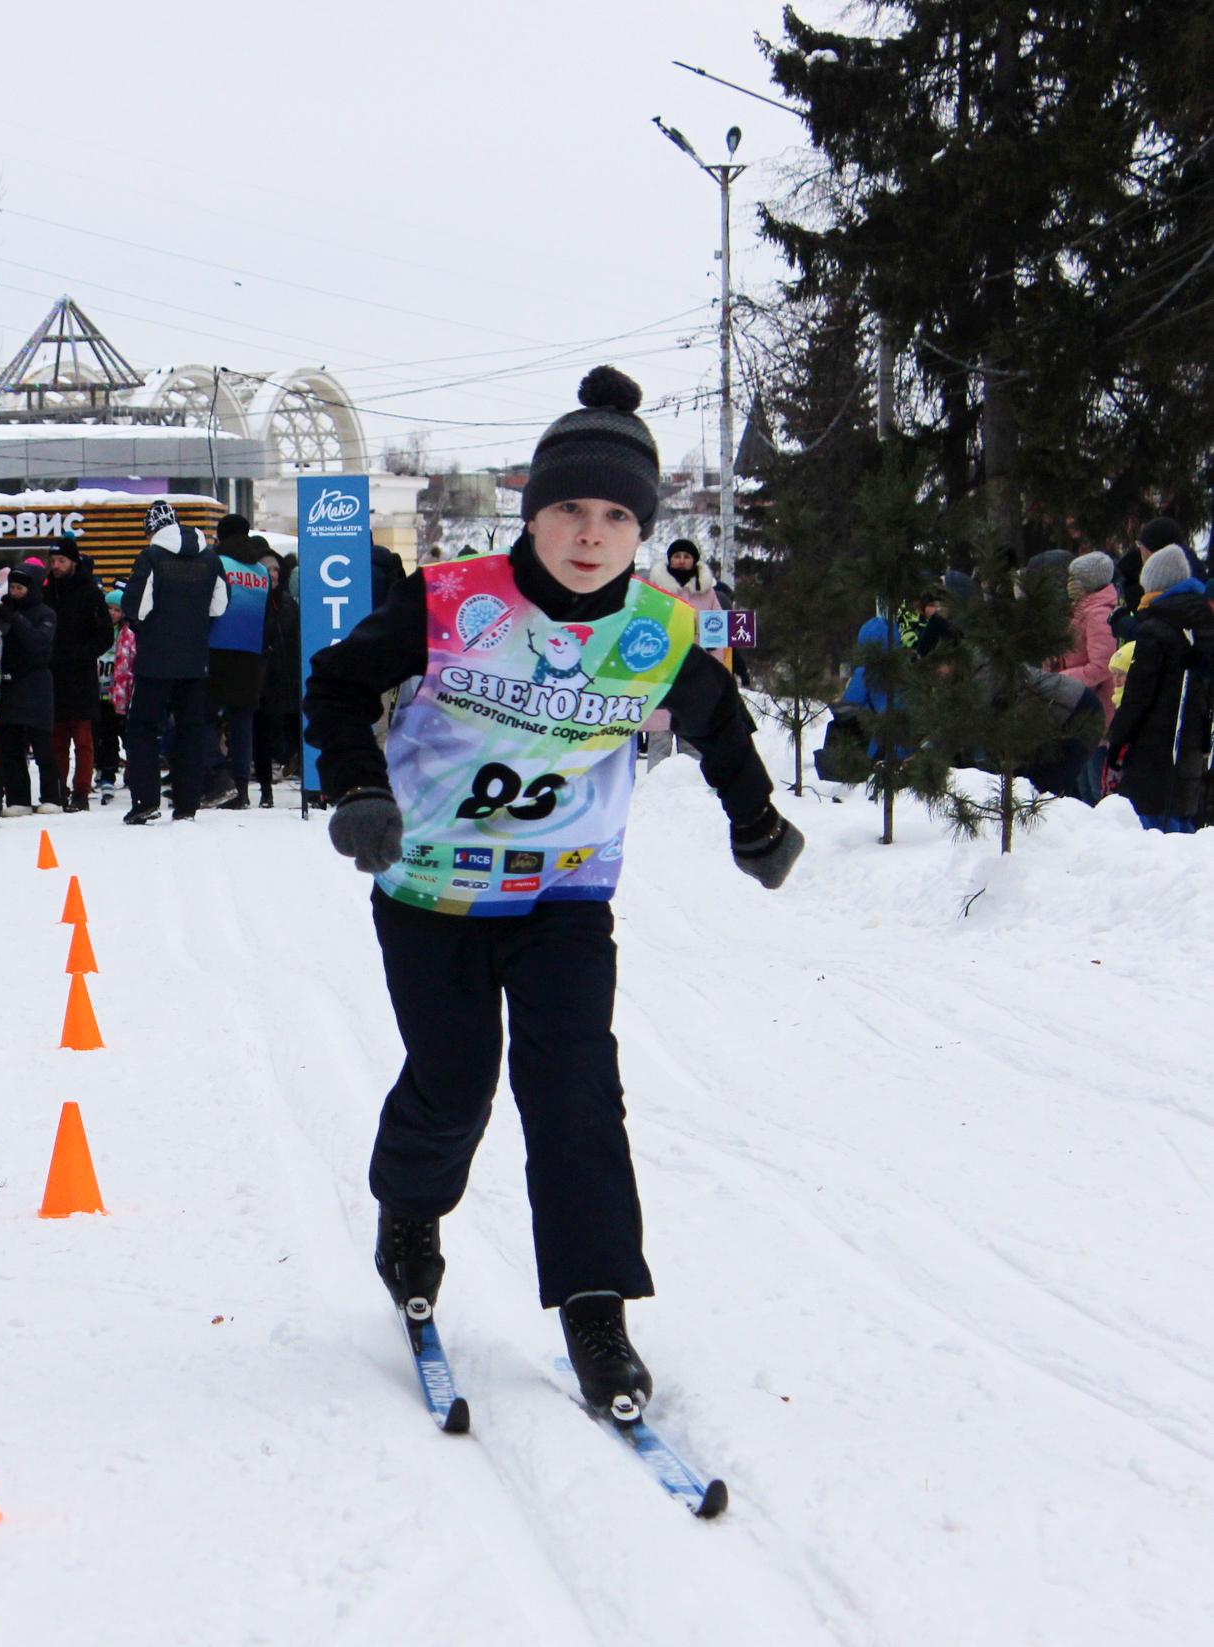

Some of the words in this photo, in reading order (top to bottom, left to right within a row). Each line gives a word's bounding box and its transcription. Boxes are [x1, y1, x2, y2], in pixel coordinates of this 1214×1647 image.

[306, 524, 342, 532] ЛЫЖНЫЙ
[226, 571, 267, 589] СУДЬЯ
[320, 554, 352, 646] СТ
[437, 691, 546, 735] многоэтапные
[439, 666, 648, 726] СНЕГОВИК
[455, 762, 568, 820] 83
[469, 854, 491, 864] ПСБ
